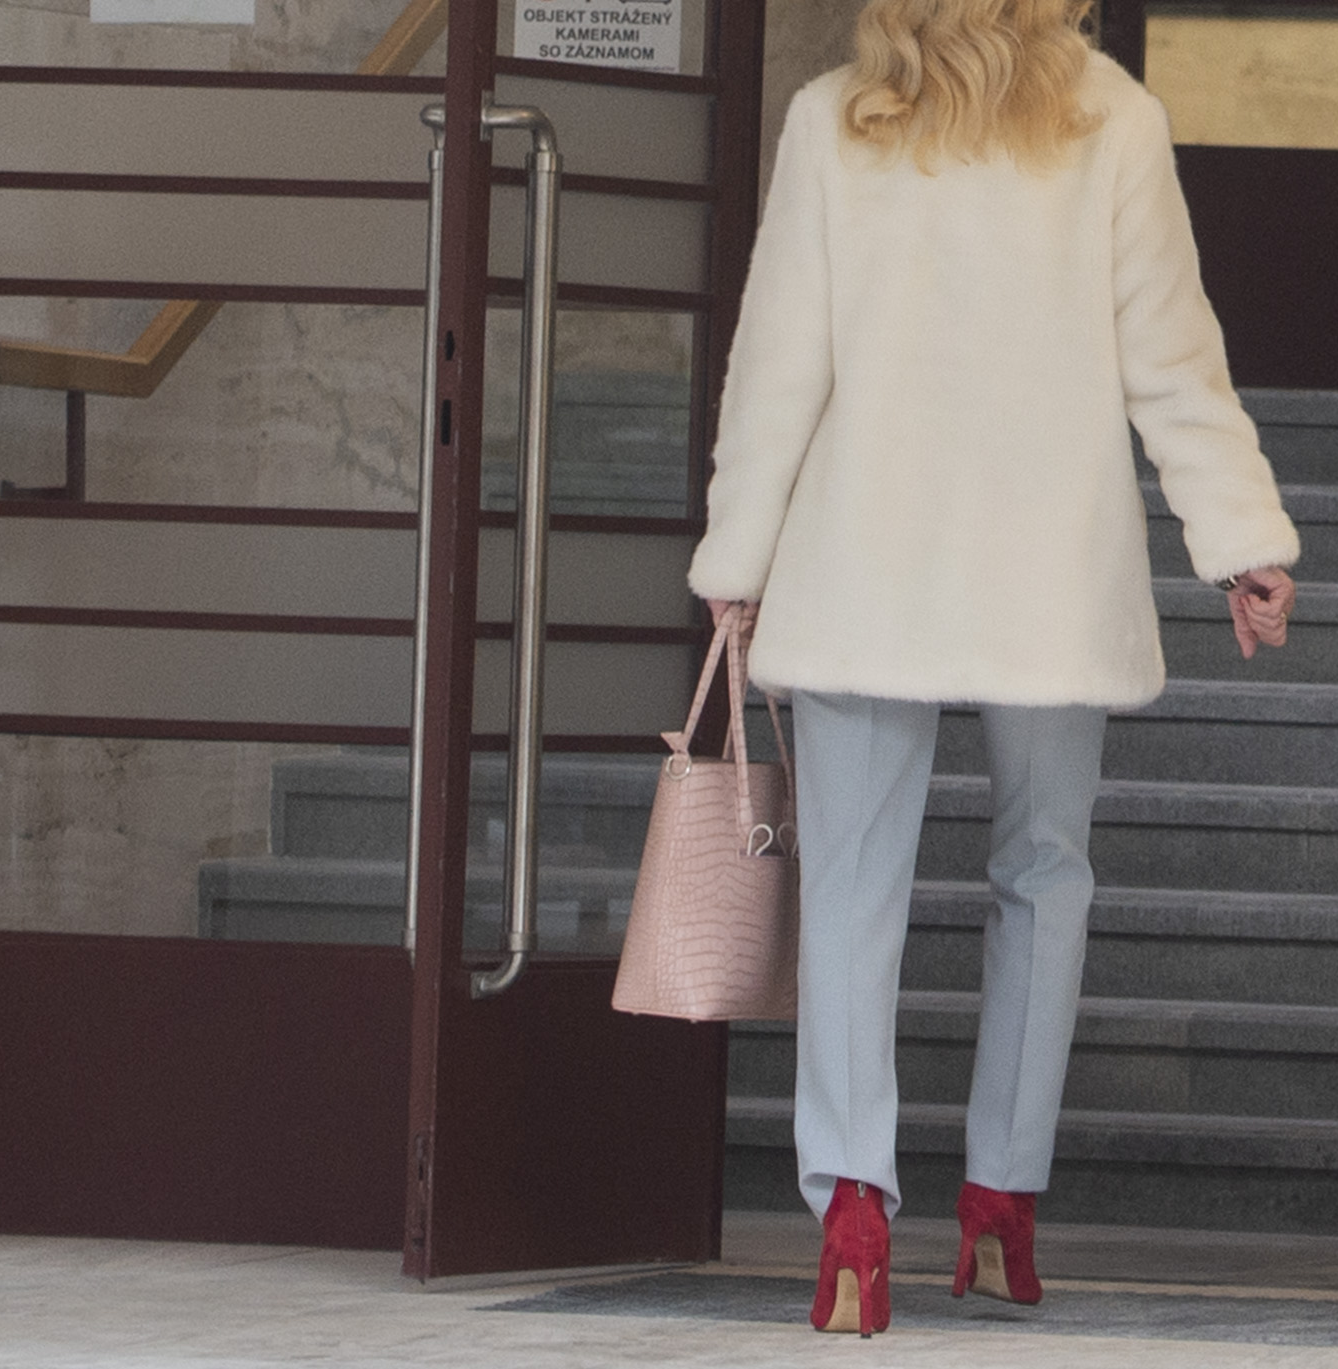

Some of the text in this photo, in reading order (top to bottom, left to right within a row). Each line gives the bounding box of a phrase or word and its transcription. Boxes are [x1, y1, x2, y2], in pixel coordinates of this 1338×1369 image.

[523, 8, 672, 25] OBJEKT STRÁŽENÝ
[556, 28, 640, 42] KAMERAMI
[539, 44, 654, 60] SO ZÁZNAMOM
